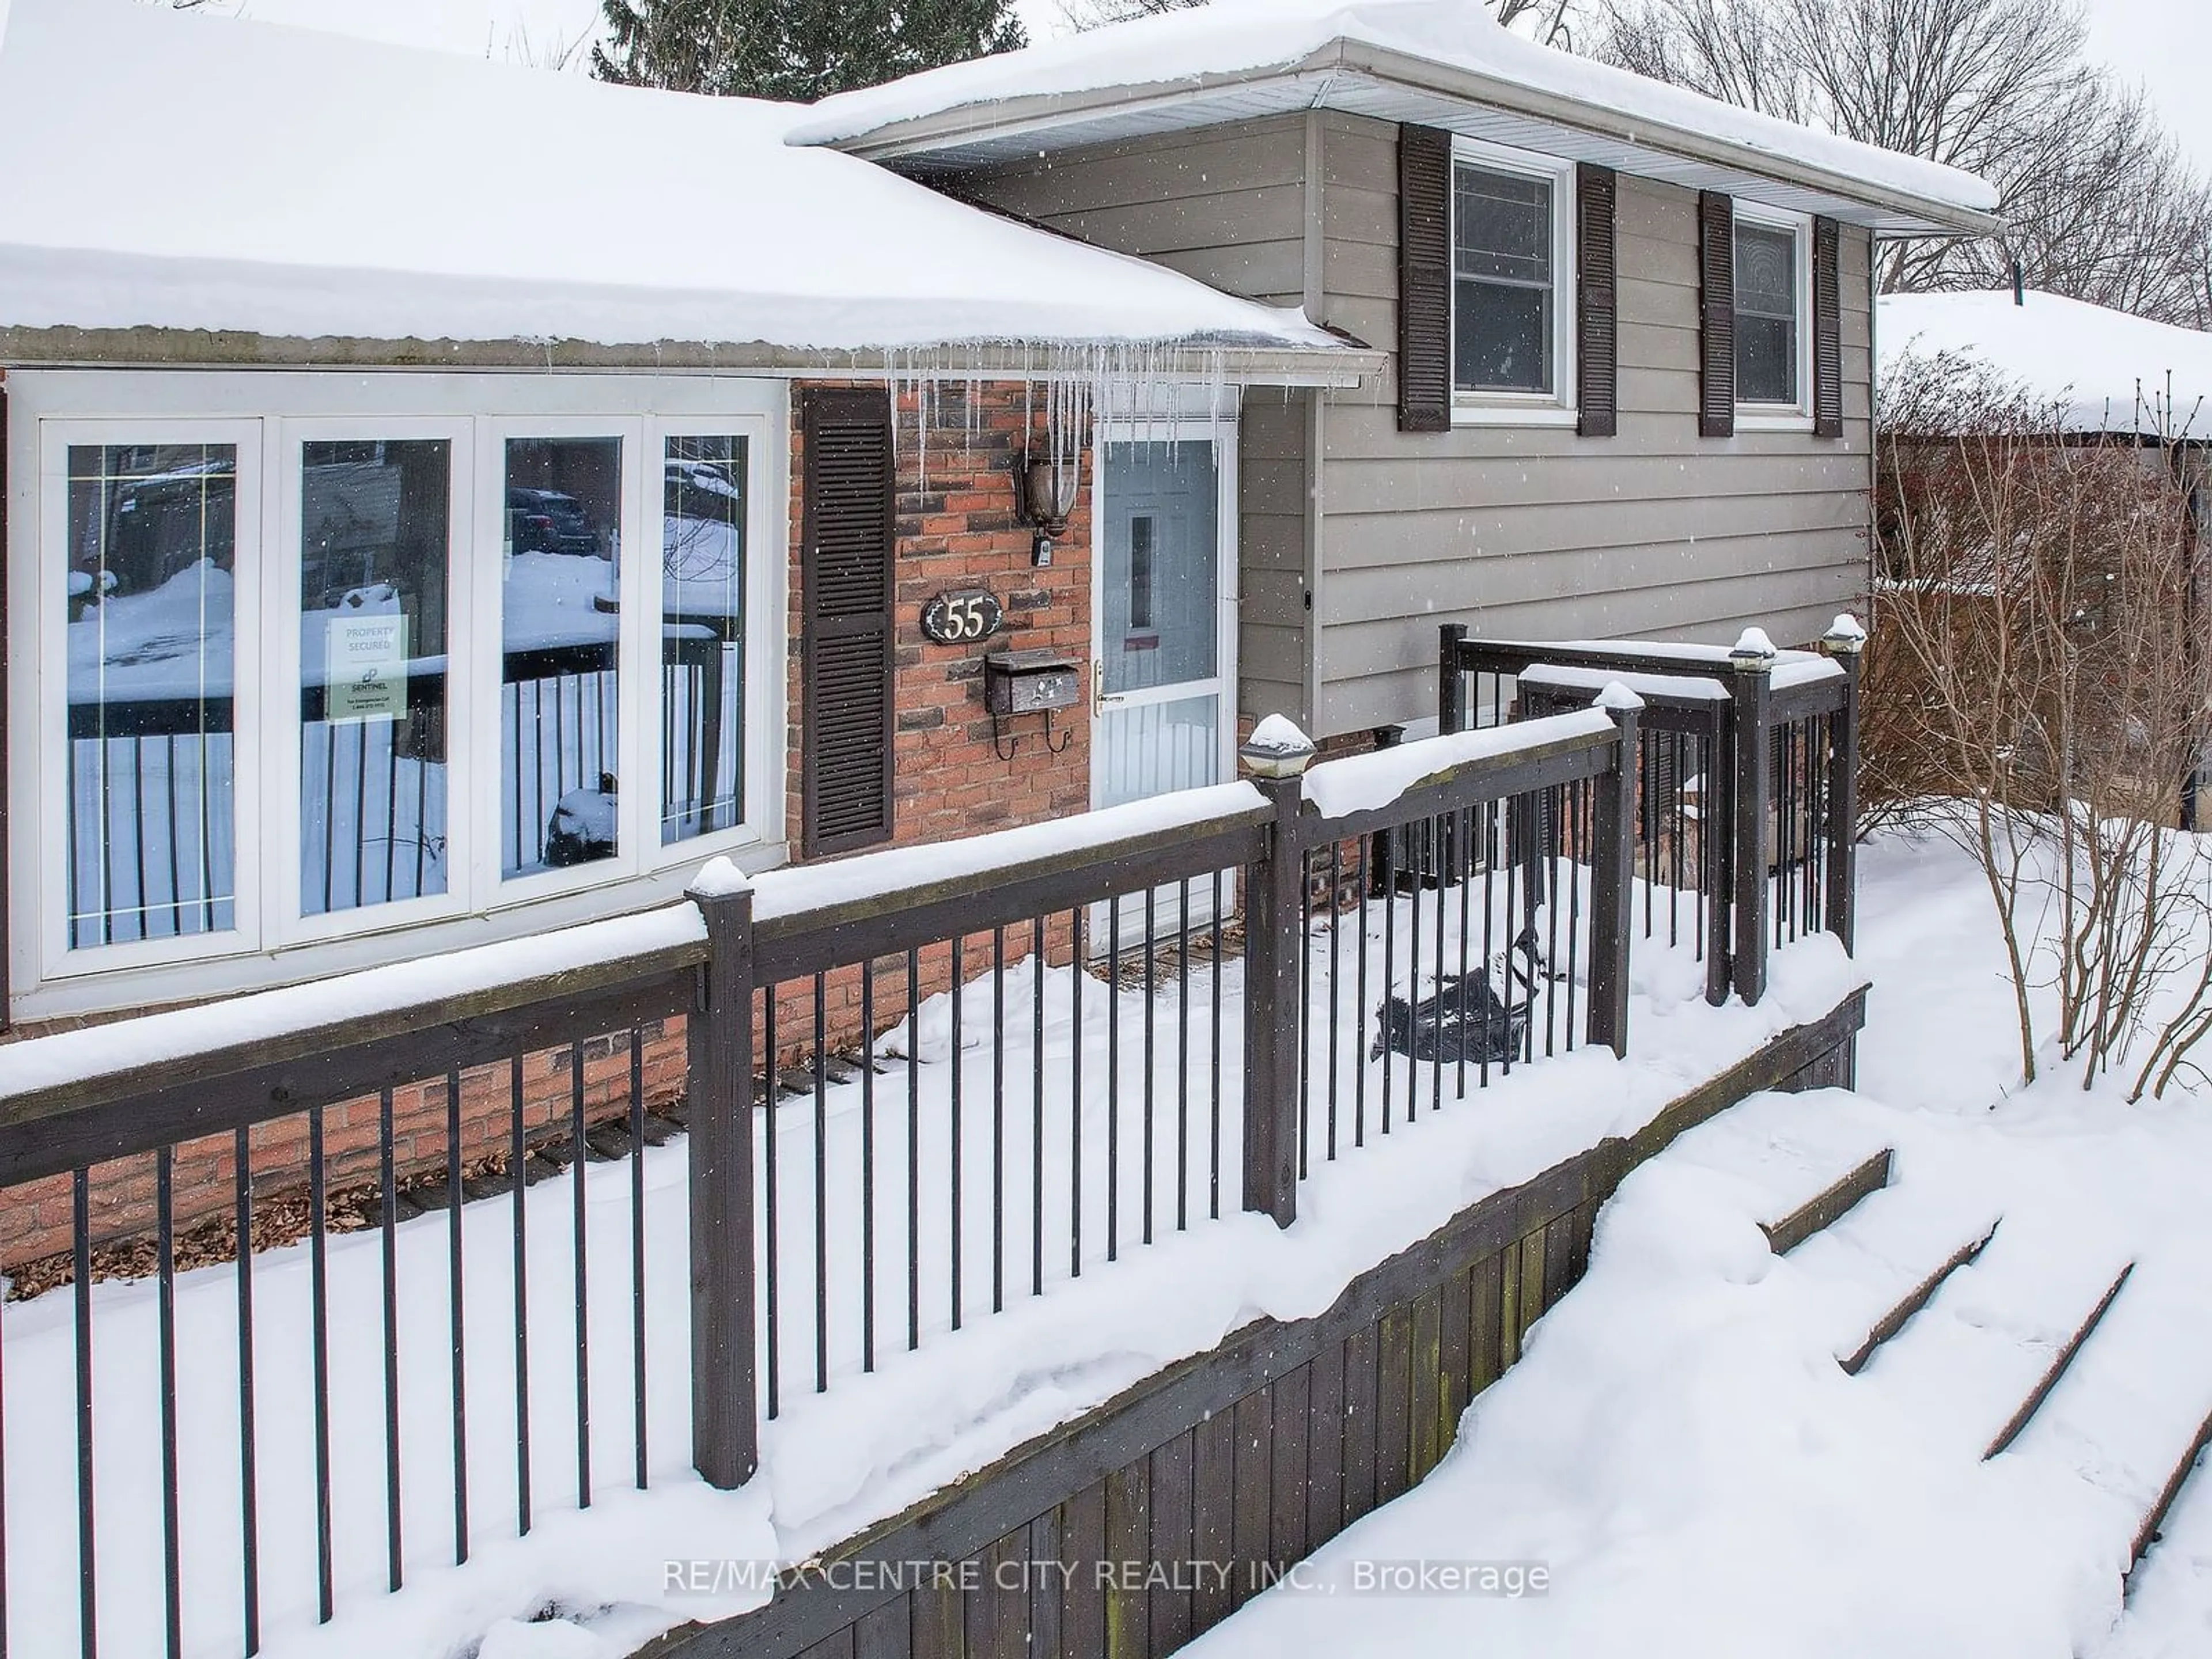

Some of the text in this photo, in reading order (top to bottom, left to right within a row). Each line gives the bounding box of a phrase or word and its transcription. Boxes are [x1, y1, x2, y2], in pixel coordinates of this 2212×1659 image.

[944, 597, 983, 639] 55
[347, 627, 395, 637] PROPERTY
[349, 641, 390, 651] SECURED
[352, 683, 388, 692] SENTINEL
